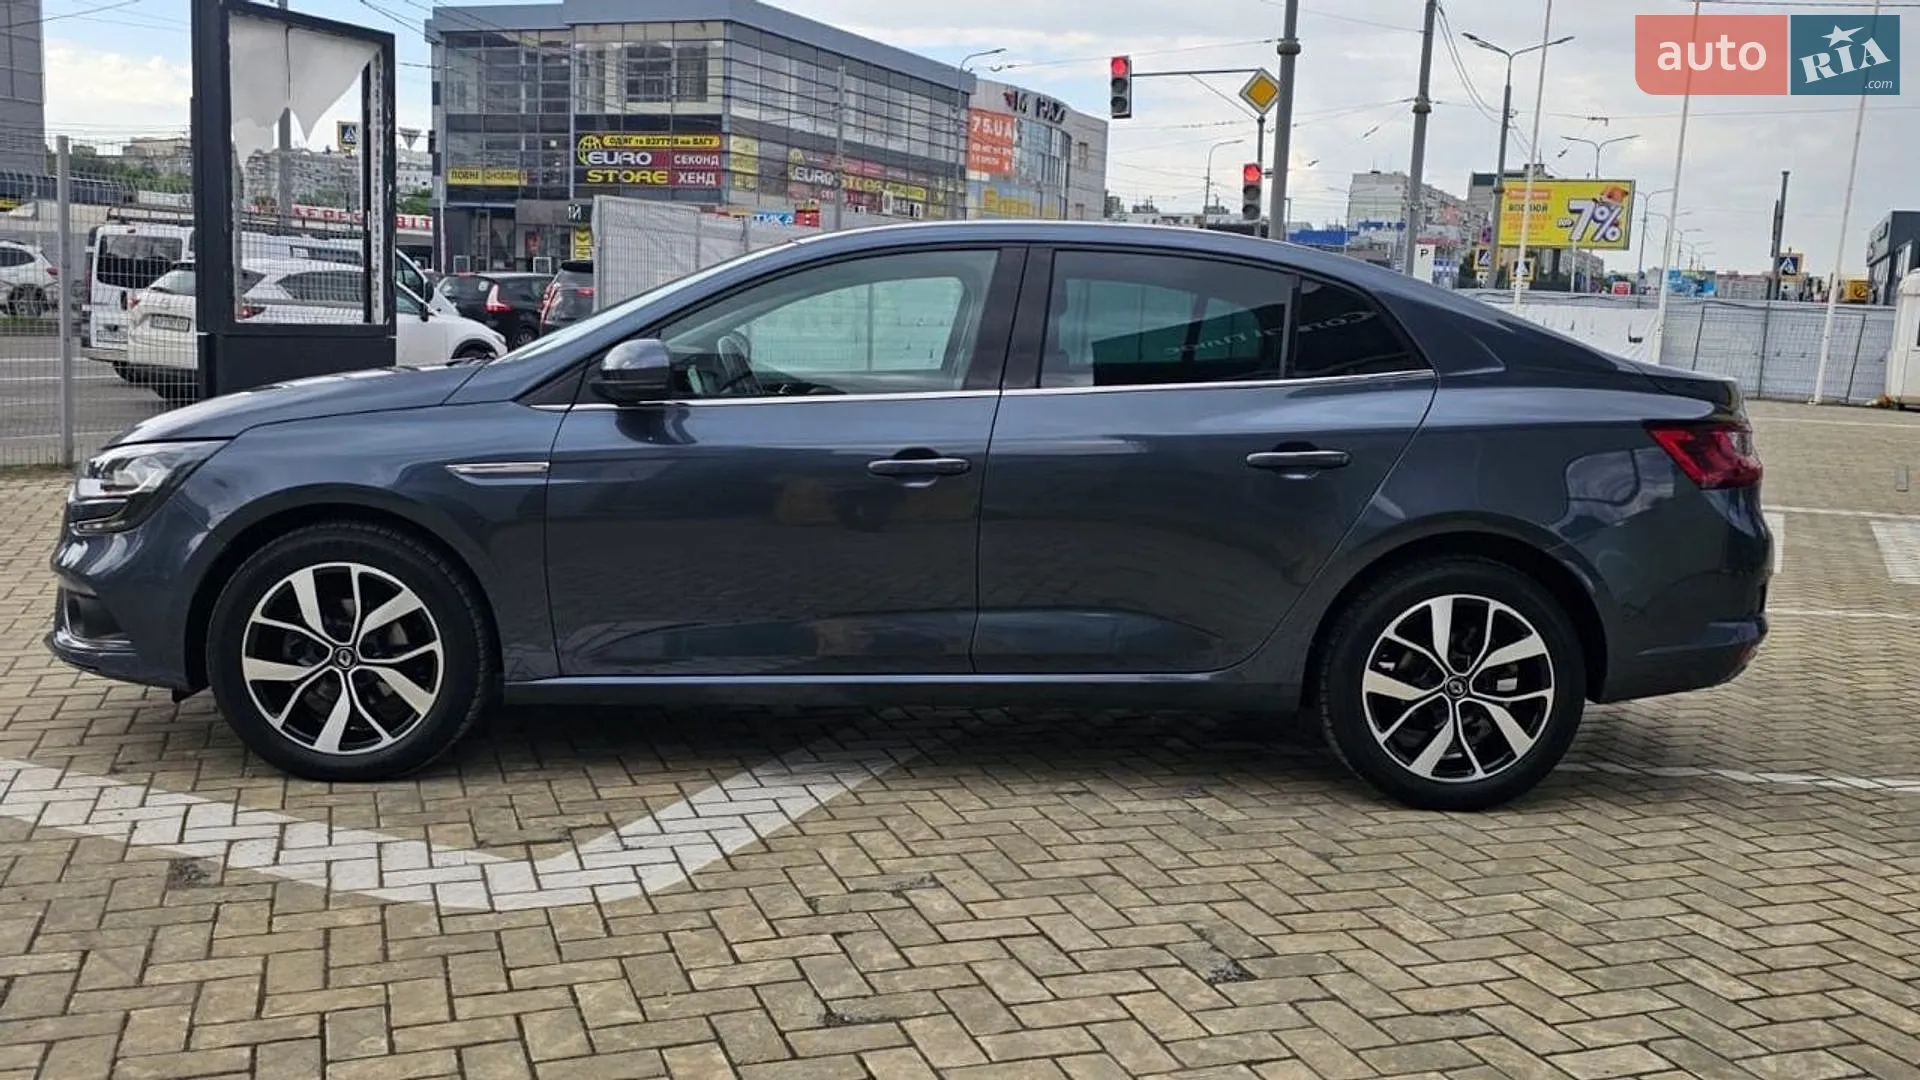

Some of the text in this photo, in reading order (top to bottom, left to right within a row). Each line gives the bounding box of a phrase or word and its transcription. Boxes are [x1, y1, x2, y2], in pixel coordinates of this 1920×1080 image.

[588, 152, 652, 165] EURO
[674, 155, 720, 166] СЕКОНД
[587, 170, 668, 184] STORE
[678, 172, 717, 186] ХЕНД
[795, 166, 834, 186] EURO
